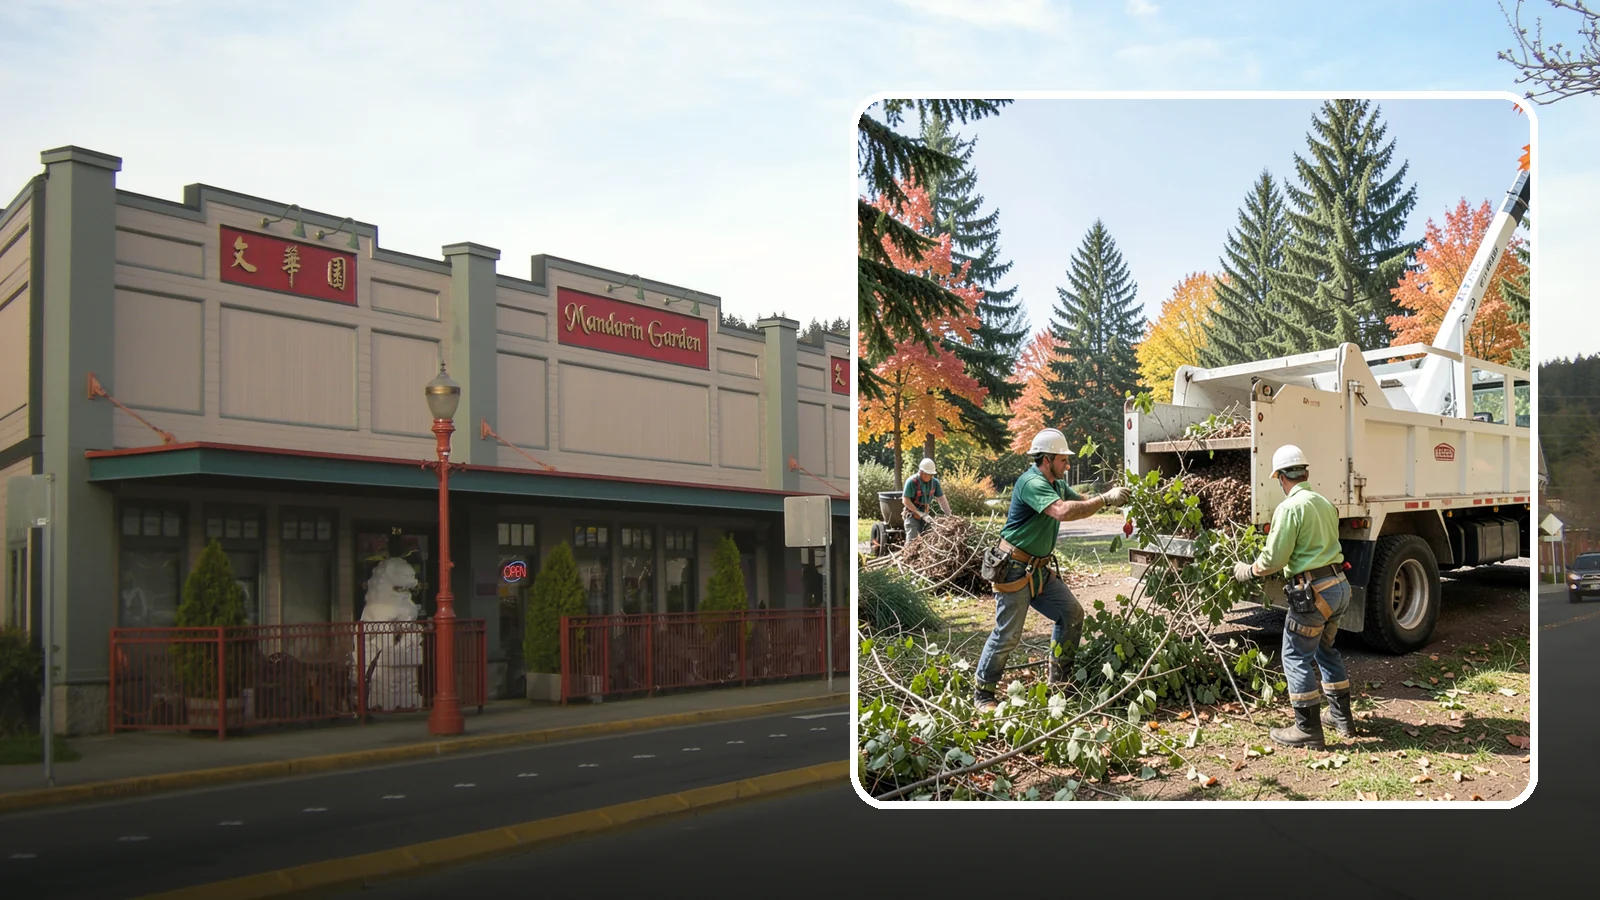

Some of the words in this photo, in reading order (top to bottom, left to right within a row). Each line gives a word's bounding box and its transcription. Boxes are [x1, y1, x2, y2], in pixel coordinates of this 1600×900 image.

[230, 235, 347, 291] 文華園
[564, 302, 644, 341] Mandarin
[647, 320, 701, 352] Garden
[503, 565, 527, 578] OPEN
